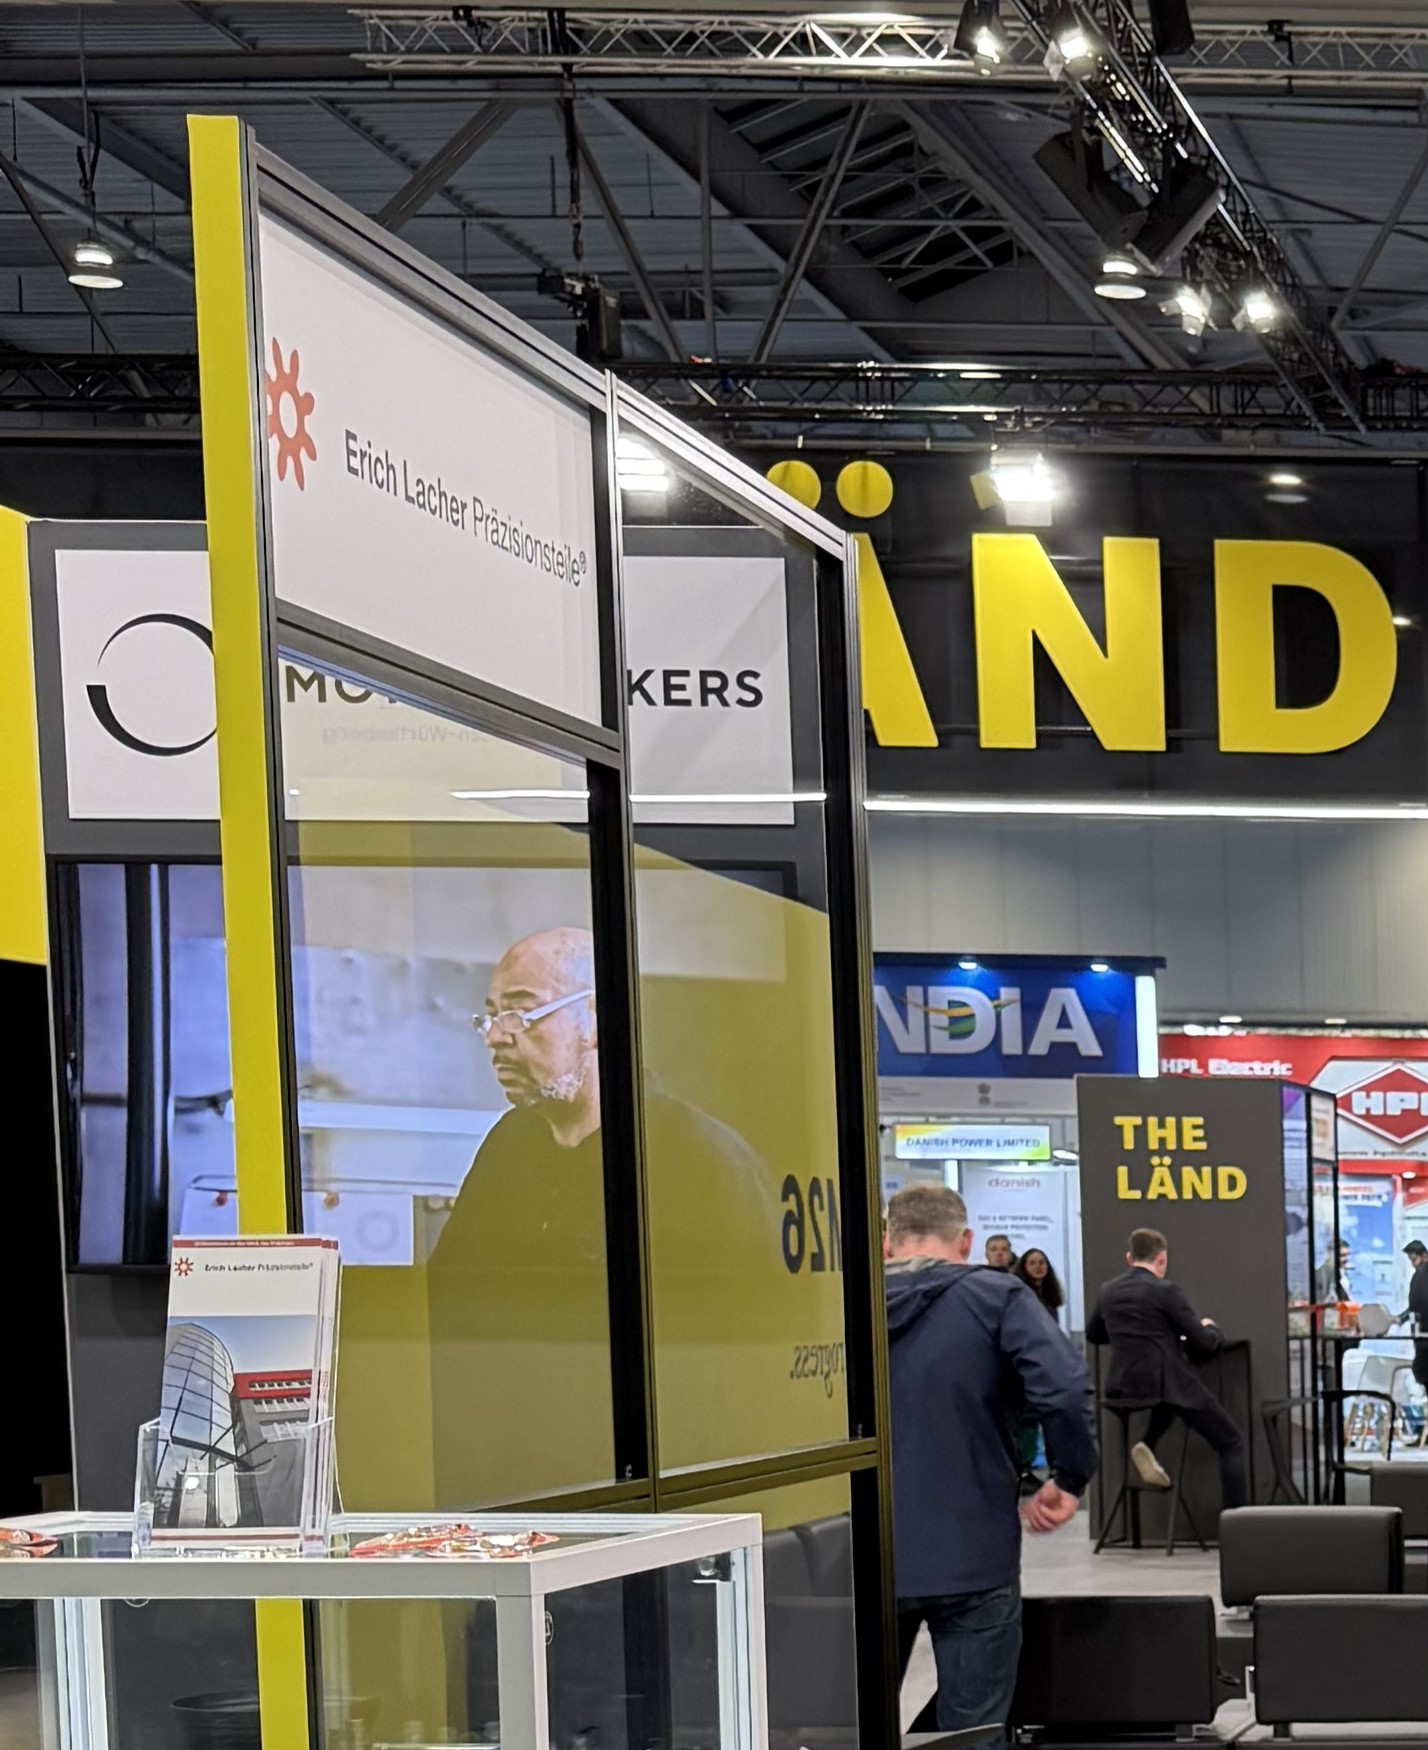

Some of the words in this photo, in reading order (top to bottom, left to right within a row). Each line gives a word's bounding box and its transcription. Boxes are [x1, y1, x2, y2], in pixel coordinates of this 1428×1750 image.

[345, 429, 398, 497] Erich
[402, 459, 468, 531] Lacher
[1161, 1058, 1204, 1075] HPL
[1207, 1058, 1293, 1076] Electric
[906, 1137, 949, 1148] DANISH
[952, 1137, 992, 1148] POWER
[996, 1137, 1041, 1148] LIMITED
[1113, 1115, 1208, 1150] THE
[1117, 1155, 1248, 1200] LÄND
